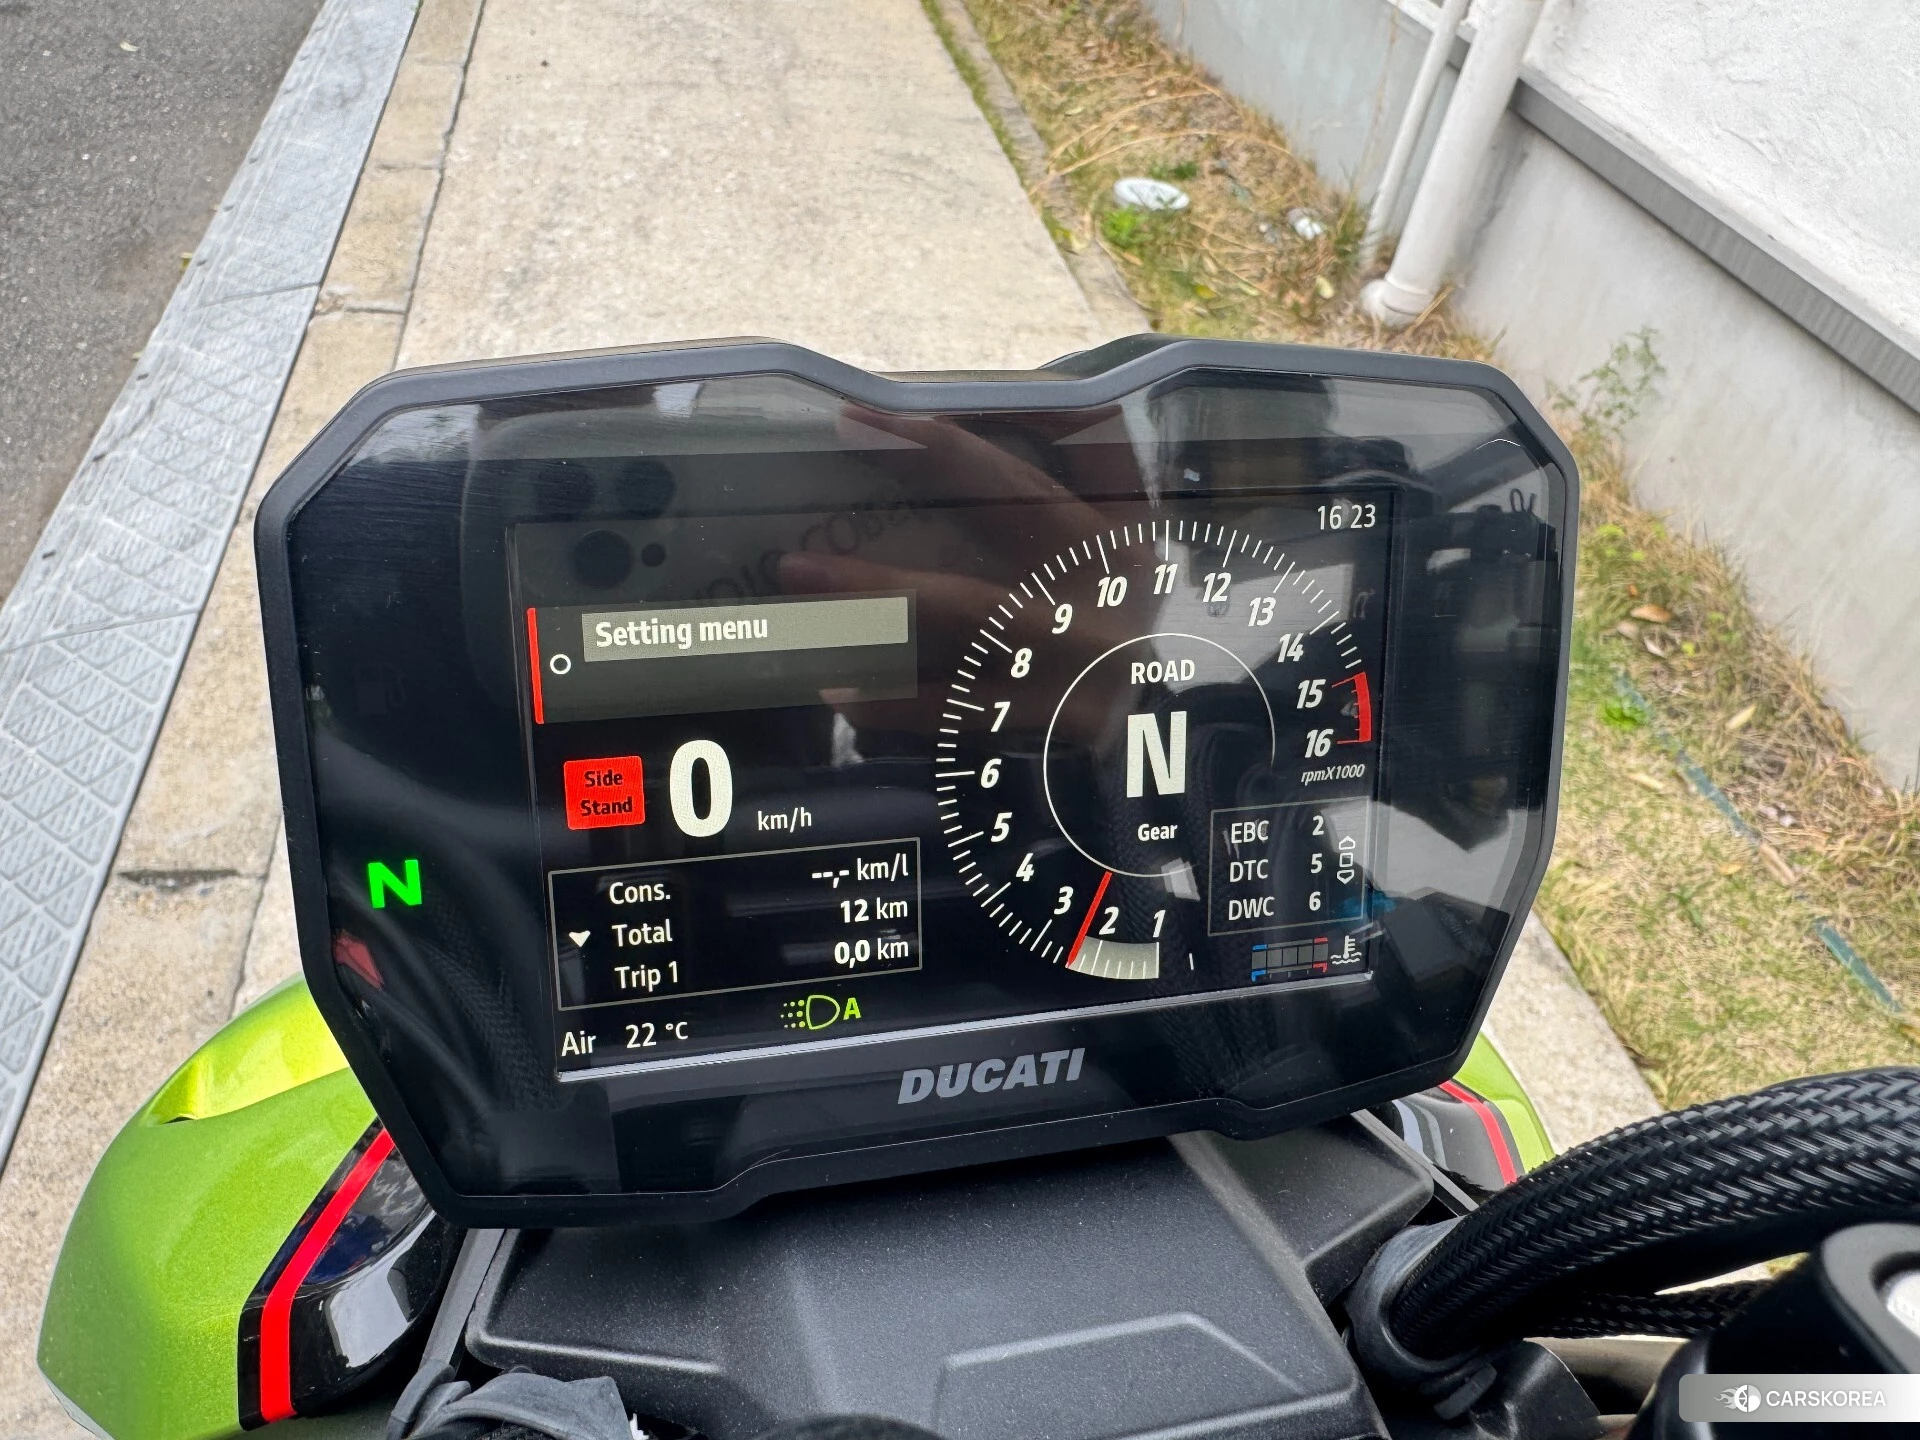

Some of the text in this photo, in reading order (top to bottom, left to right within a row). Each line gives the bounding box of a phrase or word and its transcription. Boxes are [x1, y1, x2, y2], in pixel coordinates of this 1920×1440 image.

[1097, 576, 1127, 607] 10
[1153, 564, 1178, 594] 11
[1202, 573, 1232, 603] 12
[1052, 604, 1073, 634] 9
[1247, 597, 1276, 627] 13
[595, 618, 769, 649] Setting menu
[1277, 633, 1304, 662] 14
[1010, 648, 1033, 678] 8
[1130, 659, 1196, 684] ROAD
[1296, 679, 1327, 709] 15
[990, 701, 1010, 732] 7
[1126, 710, 1188, 798] N
[1304, 728, 1333, 758] 16
[584, 770, 624, 787] Side
[980, 758, 1002, 788] 6
[1300, 763, 1366, 784] rpmX1000
[669, 739, 733, 838] 0
[580, 798, 634, 818] Stand
[757, 807, 813, 831] km/h
[991, 812, 1013, 842] 5
[1137, 822, 1179, 843] Gear
[1230, 815, 1325, 844] EBC 2
[609, 881, 671, 905] Cons.
[856, 853, 909, 881] km/l
[1015, 853, 1036, 882] 4
[1229, 854, 1324, 883] DTC 5
[368, 859, 422, 909] N
[1053, 886, 1074, 915] 3
[1228, 891, 1322, 921] DWC 6
[612, 898, 909, 947] Total 12 km
[1098, 906, 1119, 935] 2
[1152, 909, 1167, 939] 1
[615, 937, 909, 992] Trip 1 0,0 km
[561, 1031, 597, 1057] Air
[625, 1023, 657, 1049] 22
[897, 1047, 1086, 1105] DUCATI
